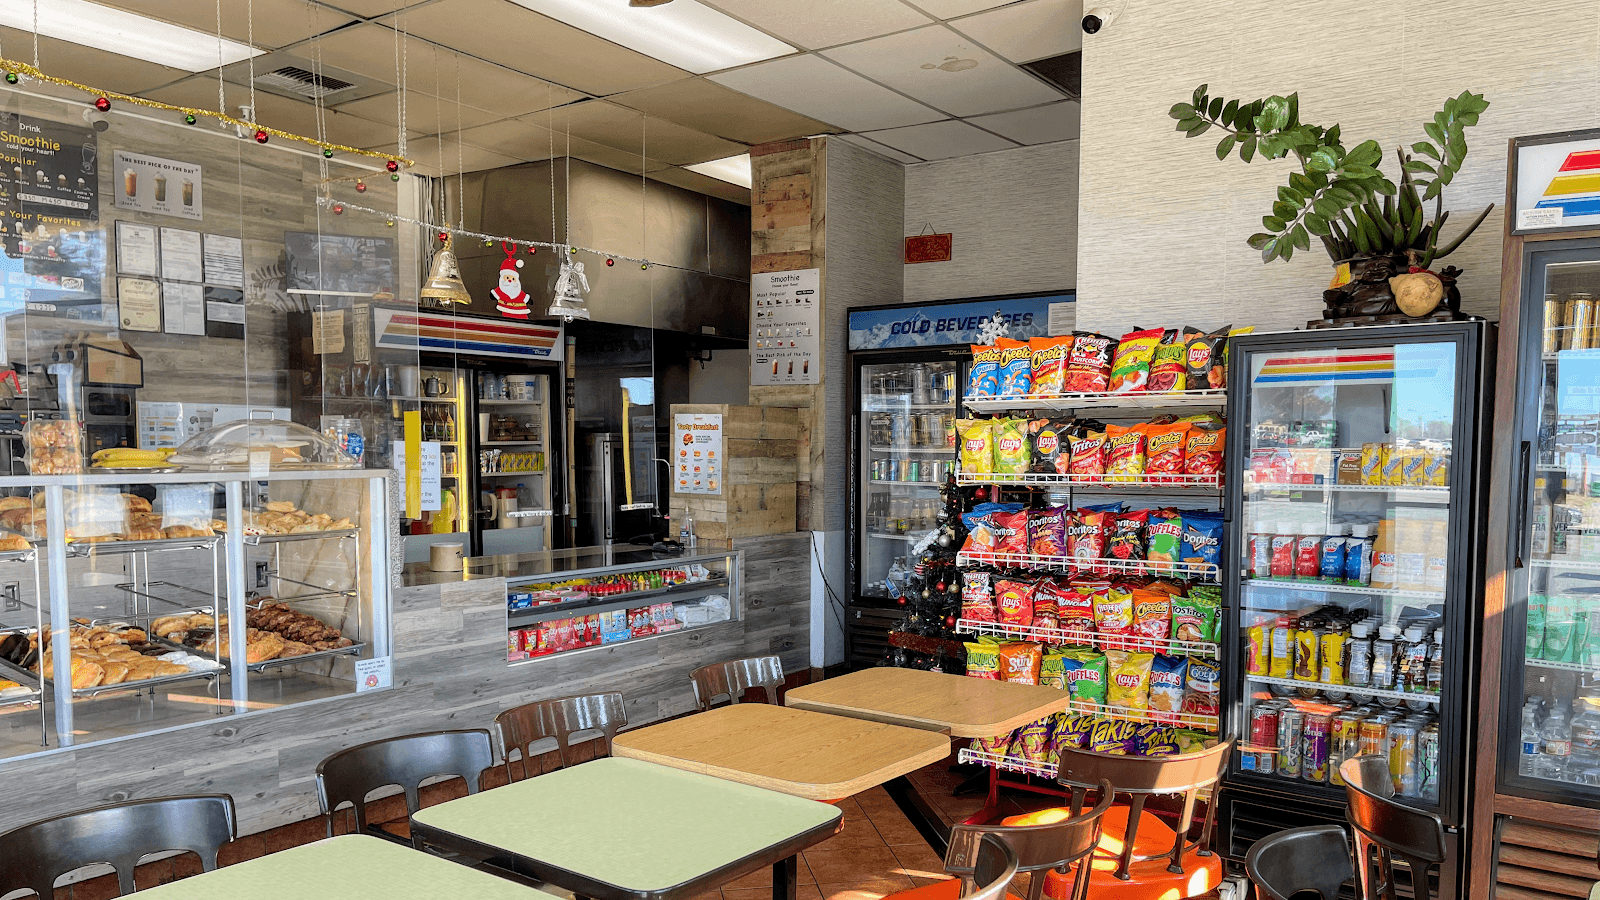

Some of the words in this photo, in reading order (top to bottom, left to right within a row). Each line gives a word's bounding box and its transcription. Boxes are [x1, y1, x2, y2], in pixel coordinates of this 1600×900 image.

[19, 123, 41, 133] Drink
[0, 131, 60, 151] Smoothie
[21, 145, 34, 153] your
[9, 210, 32, 220] Your
[37, 214, 81, 227] Favorites
[770, 274, 800, 283] Smoothie
[890, 319, 931, 335] COLD
[936, 312, 1034, 332] BEVERGES
[1000, 345, 1032, 369] Cheeto
[1031, 344, 1067, 371] Cheetos
[677, 423, 692, 431] Tasty
[692, 423, 719, 431] Breakfast
[1071, 438, 1101, 454] Fritos
[1149, 432, 1182, 452] Cheetos
[1187, 433, 1219, 453] Cheetos
[1029, 515, 1061, 529] Doritos
[1116, 520, 1141, 528] oritos
[1068, 525, 1098, 536] Doritos
[1148, 523, 1182, 538] RUFFLES
[1183, 532, 1219, 546] Doritos
[1136, 602, 1170, 618] Cheetos
[1008, 654, 1033, 673] Sun
[1067, 668, 1100, 682] RUFFLES
[1191, 668, 1217, 681] GOLD
